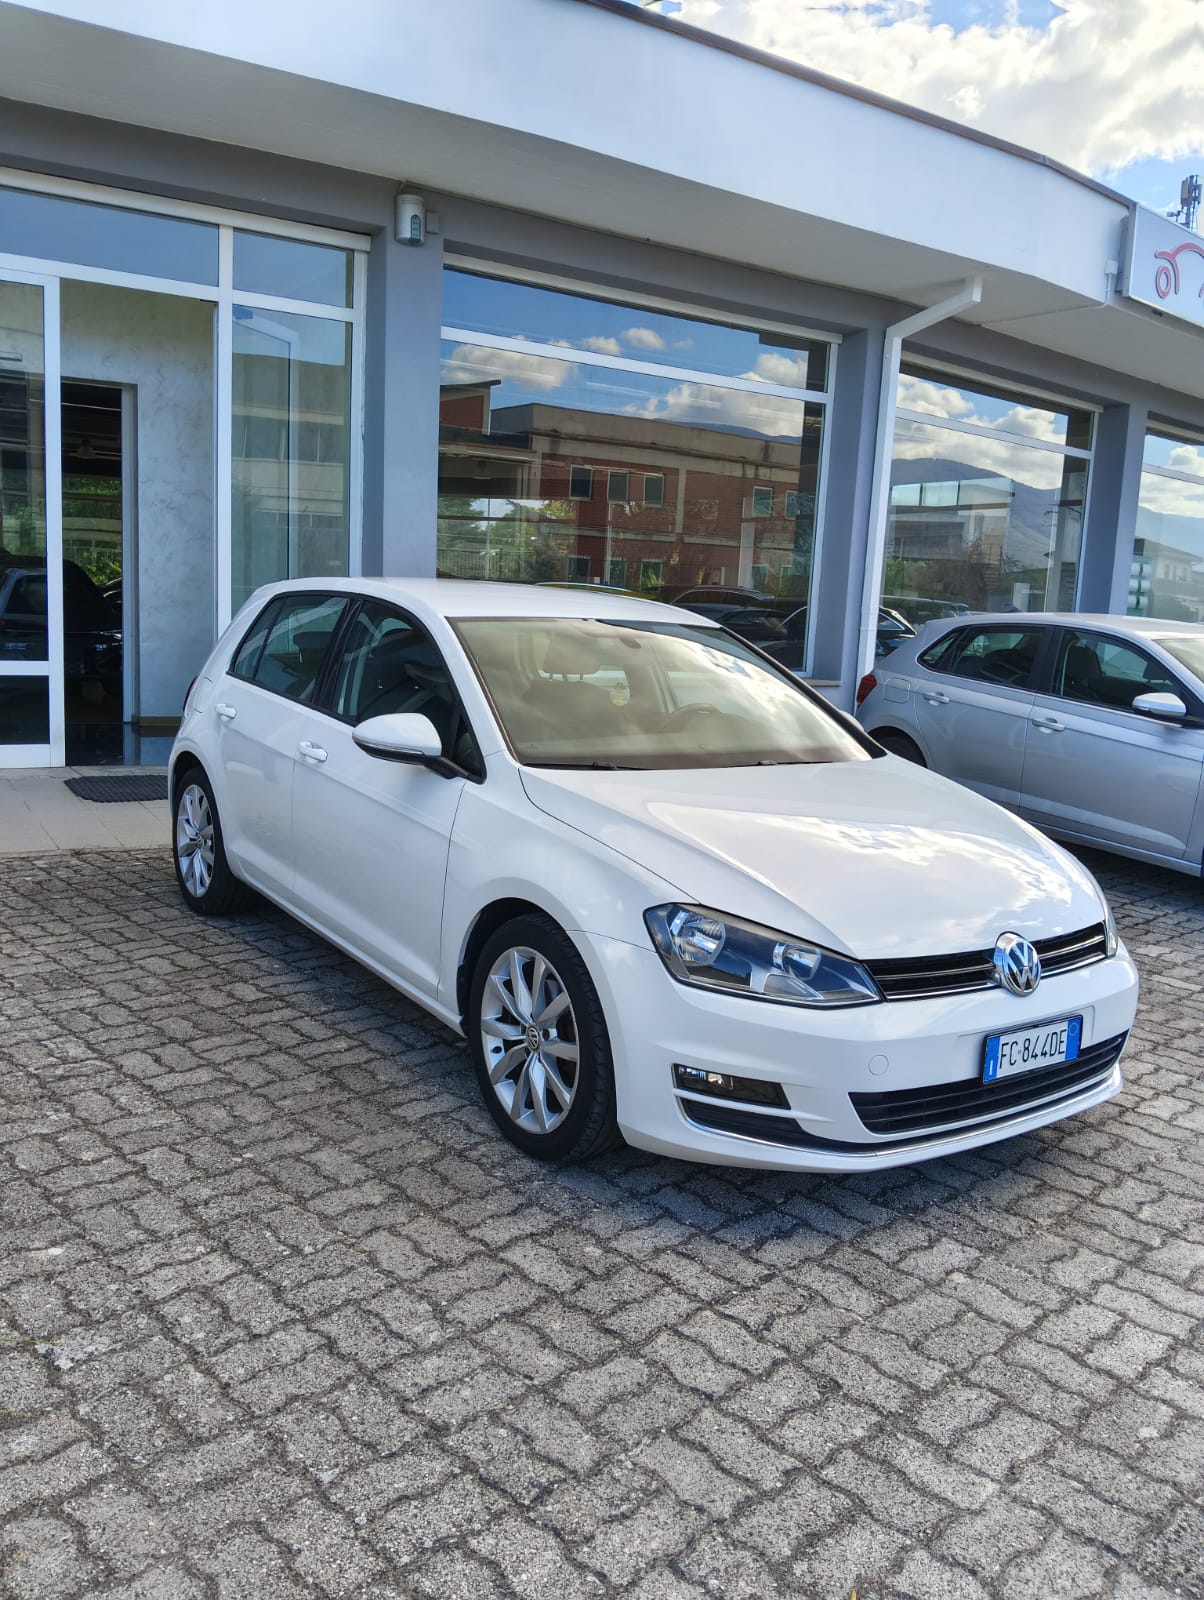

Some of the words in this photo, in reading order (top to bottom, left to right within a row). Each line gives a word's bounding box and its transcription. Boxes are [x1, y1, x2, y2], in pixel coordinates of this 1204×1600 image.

[1002, 940, 1039, 992] VW
[999, 1040, 1018, 1069] FC
[1022, 1028, 1067, 1063] 844DE
